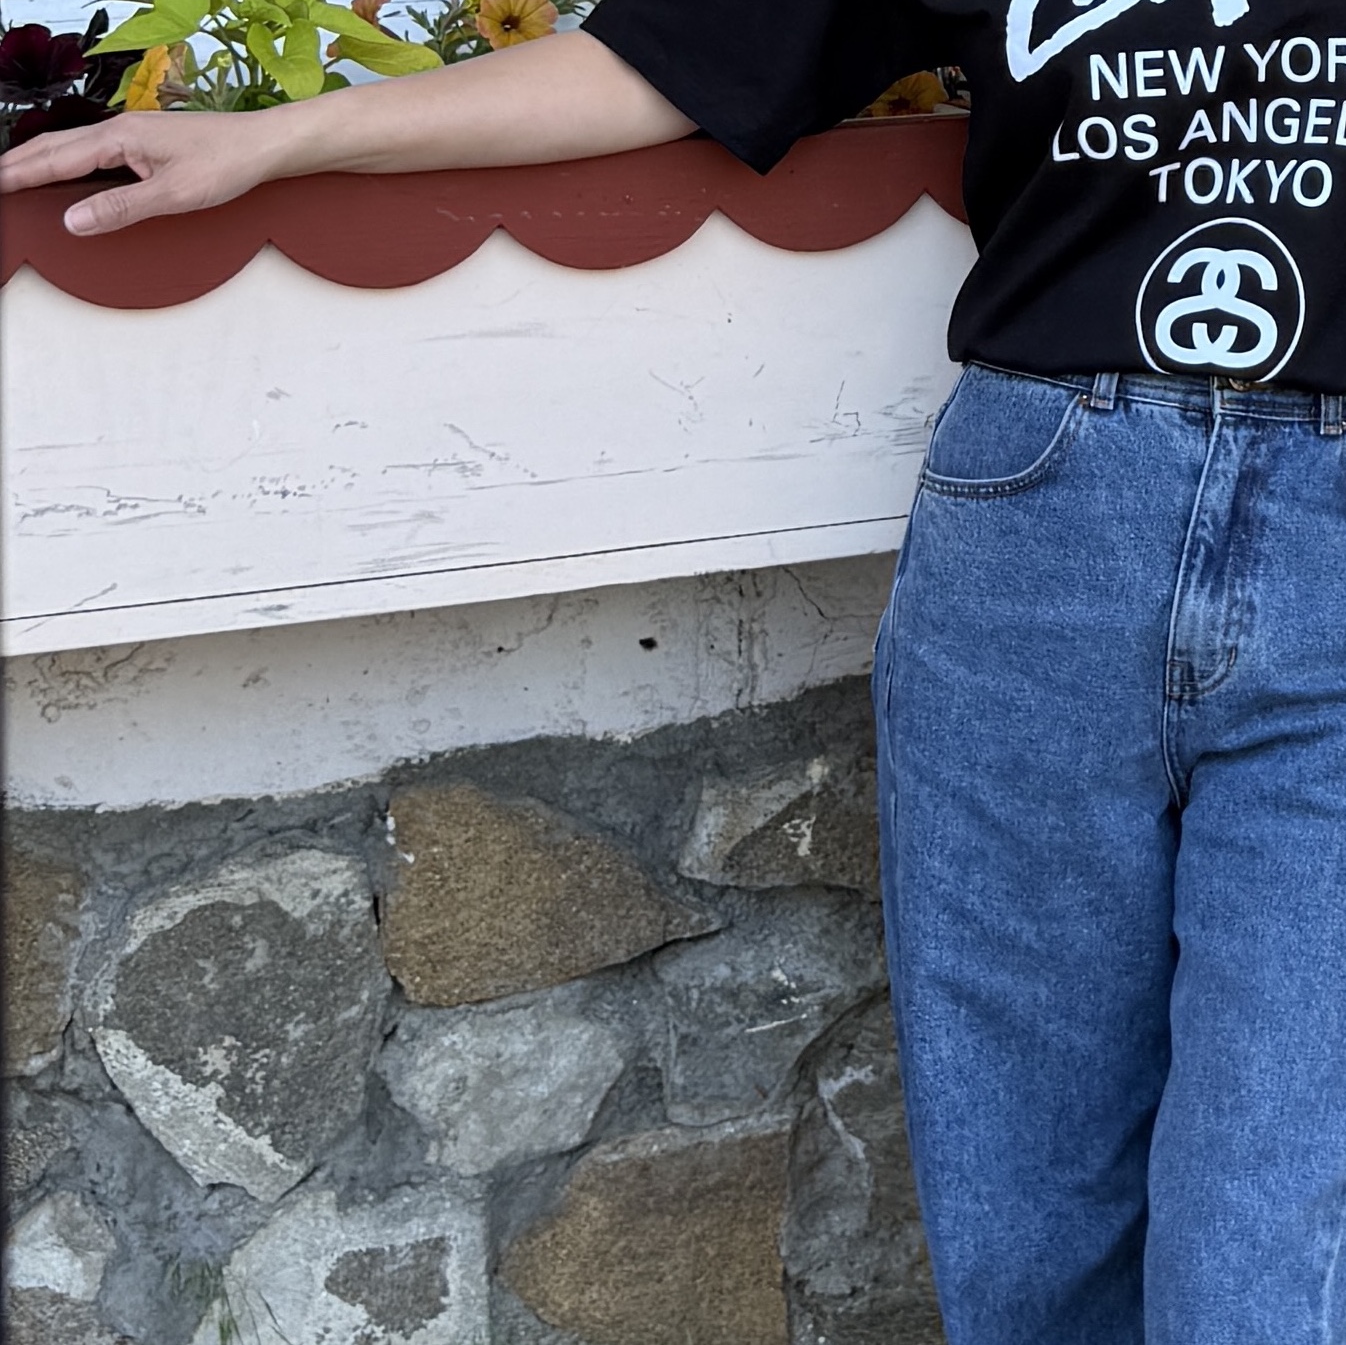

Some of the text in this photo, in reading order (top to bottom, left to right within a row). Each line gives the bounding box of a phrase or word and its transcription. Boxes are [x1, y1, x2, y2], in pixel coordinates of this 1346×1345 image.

[1089, 45, 1226, 101] NEW
[1052, 113, 1159, 162] LOS
[1148, 156, 1334, 208] TOKYO
